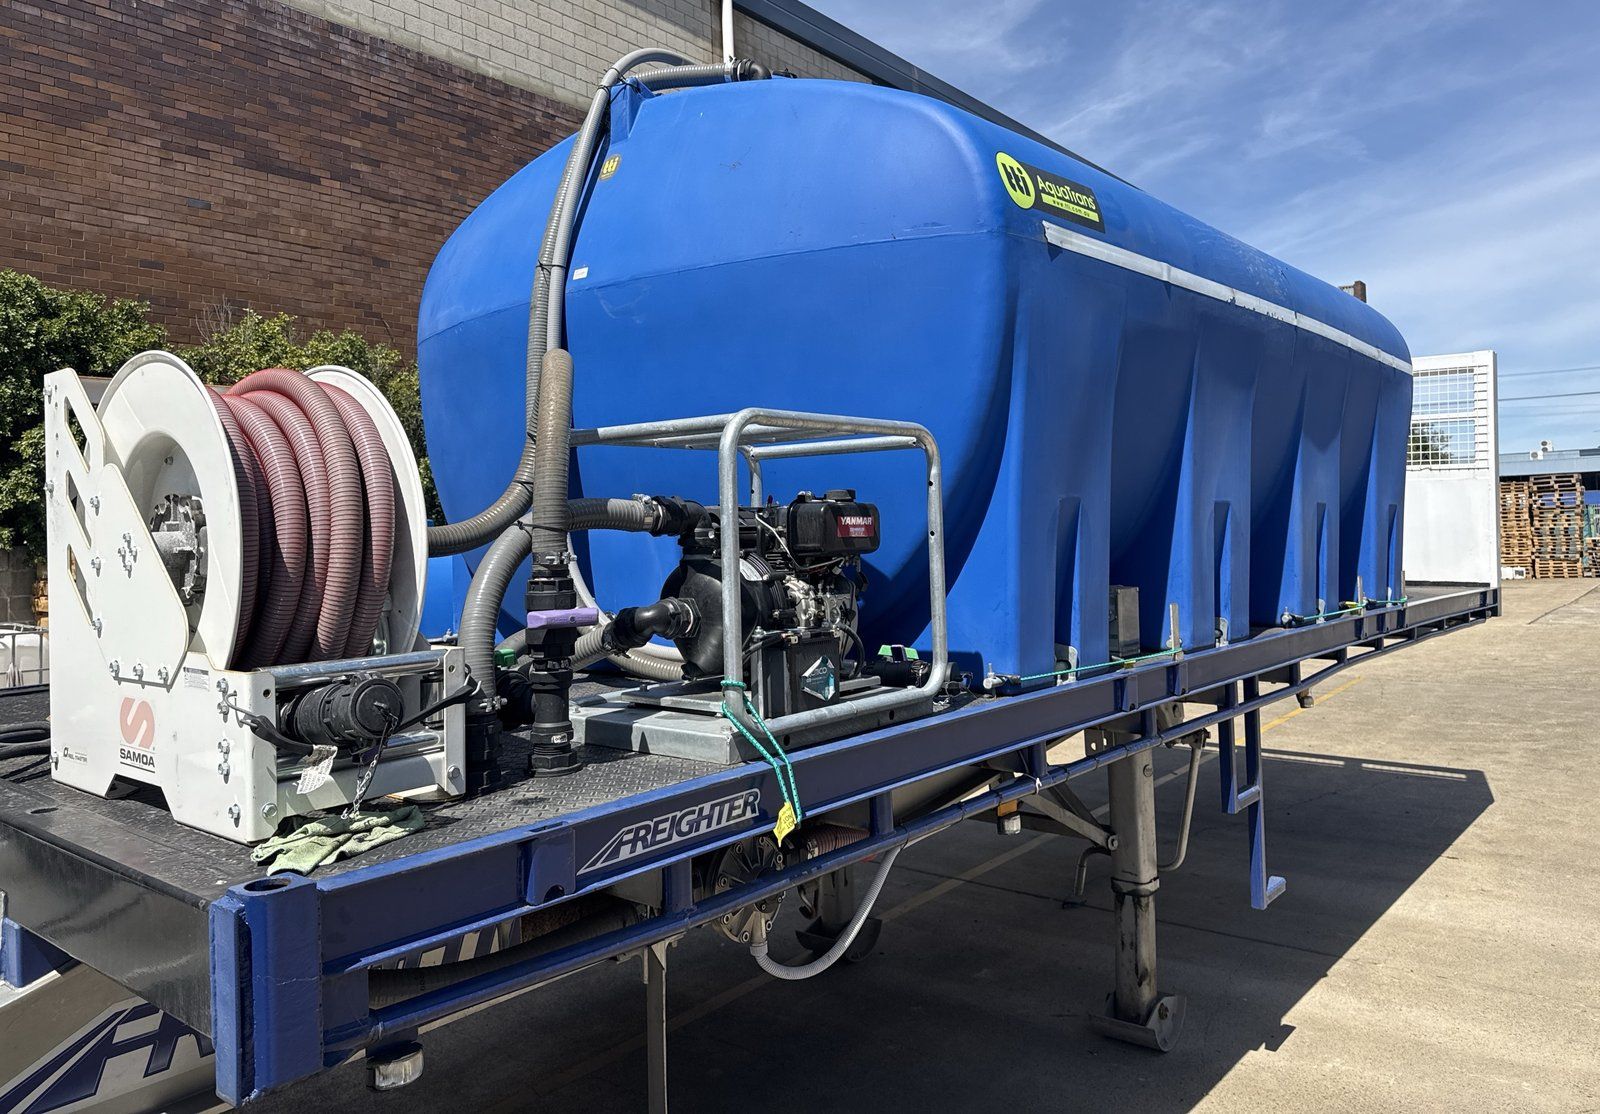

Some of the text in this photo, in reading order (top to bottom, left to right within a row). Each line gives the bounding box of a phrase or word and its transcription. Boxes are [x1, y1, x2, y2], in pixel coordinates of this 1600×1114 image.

[1037, 175, 1096, 210] AquaTrans
[840, 516, 872, 526] YANMAR
[119, 747, 156, 768] SAMOA
[582, 788, 761, 869] FREIGHTER
